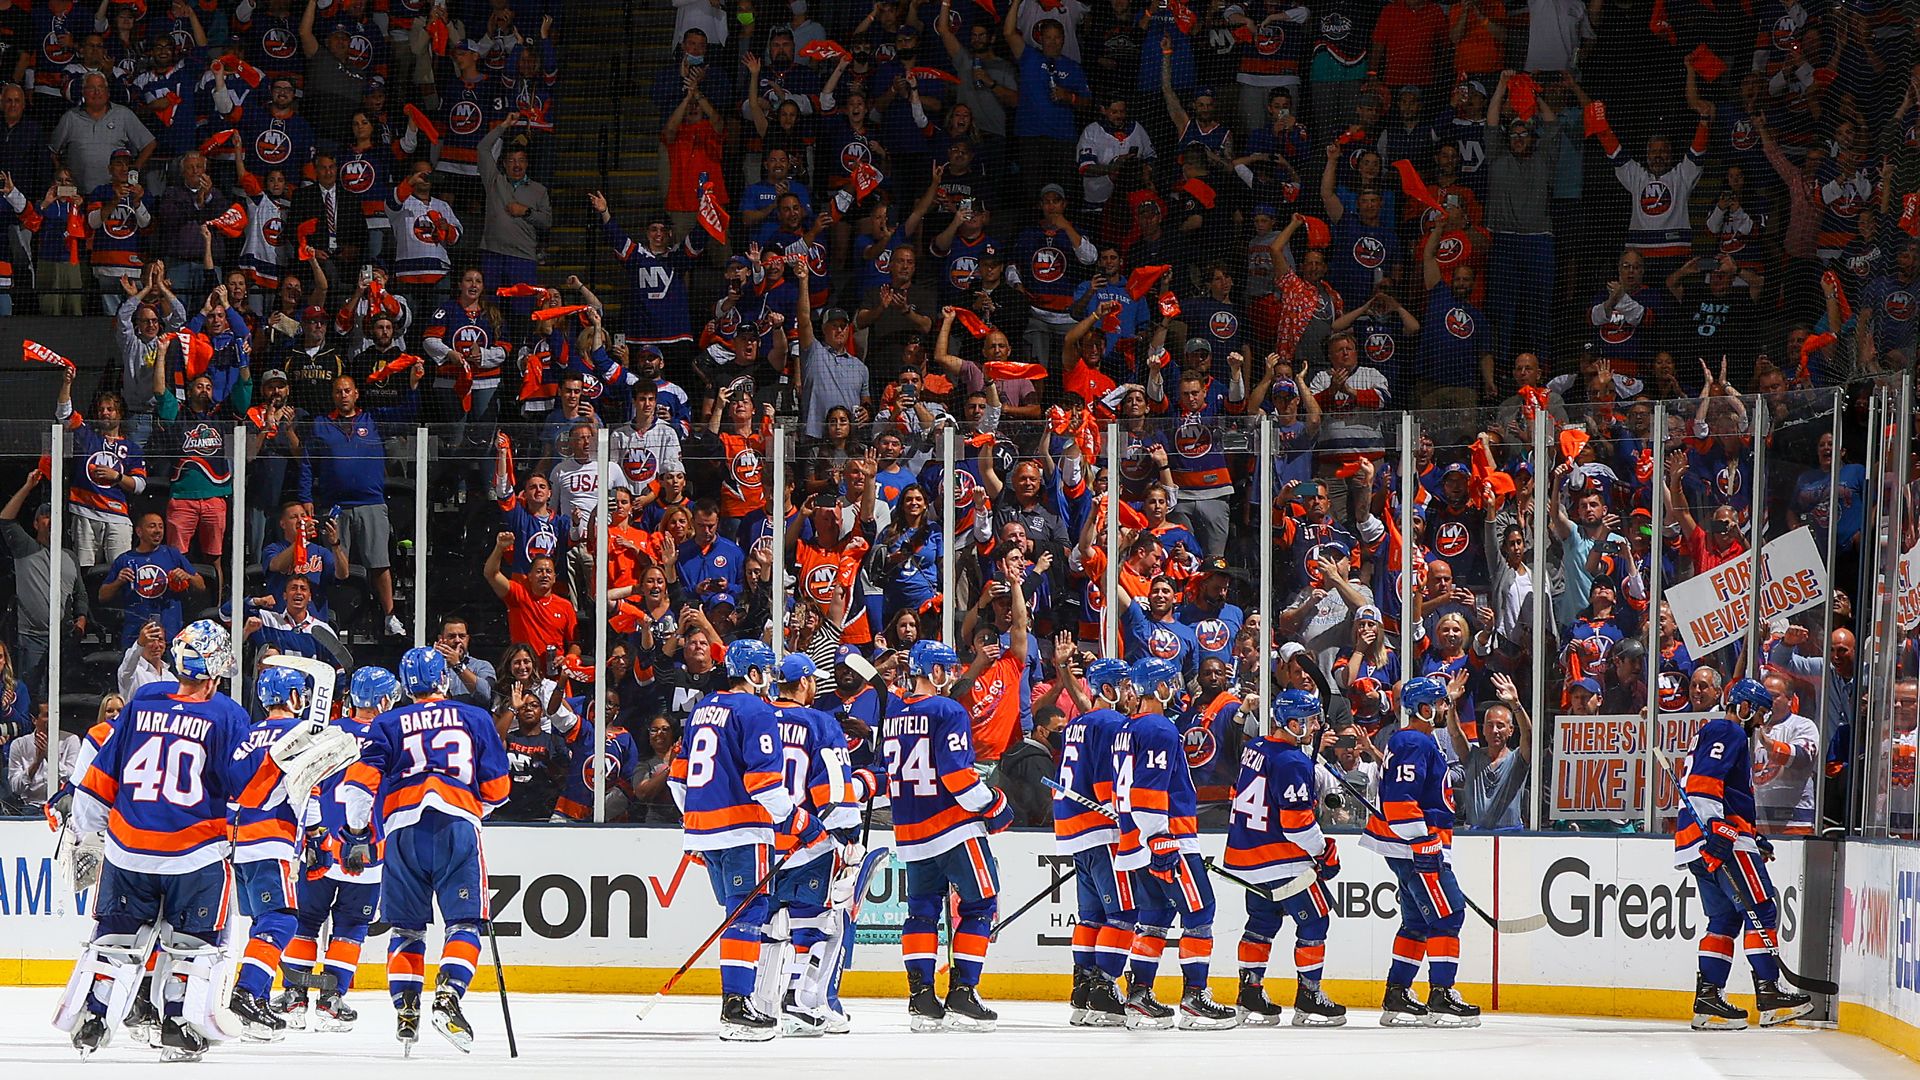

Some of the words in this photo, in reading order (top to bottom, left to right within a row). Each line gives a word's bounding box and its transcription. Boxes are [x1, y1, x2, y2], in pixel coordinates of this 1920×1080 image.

[263, 132, 285, 153] NY
[345, 162, 366, 181] NY
[638, 266, 674, 299] NY
[1213, 313, 1232, 330] NY
[1370, 336, 1387, 354] NY
[295, 370, 333, 381] BRUINS
[117, 445, 128, 459] C
[627, 448, 650, 472] NY
[569, 474, 597, 492] USA
[138, 568, 159, 586] NY
[814, 568, 838, 592] NY
[1151, 631, 1173, 650] NY
[1201, 621, 1221, 643] NY
[136, 711, 212, 740] VARLAMOV
[401, 708, 463, 733] BARZAL
[883, 714, 930, 738] MAYFIELD
[759, 734, 772, 754] 8
[947, 731, 968, 752] 24
[1187, 732, 1207, 752] NY
[1559, 721, 1637, 755] THERE'S
[401, 731, 474, 784] 13
[692, 727, 718, 787] 8
[1146, 750, 1166, 770] 14
[1709, 742, 1724, 761] 2
[124, 737, 208, 807] 40
[884, 739, 937, 798] 24
[1394, 764, 1414, 783] 15
[1283, 783, 1308, 803] 44
[1556, 759, 1627, 812] LIKE
[1541, 856, 1697, 943] Great
[1748, 908, 1779, 957] BAUER
